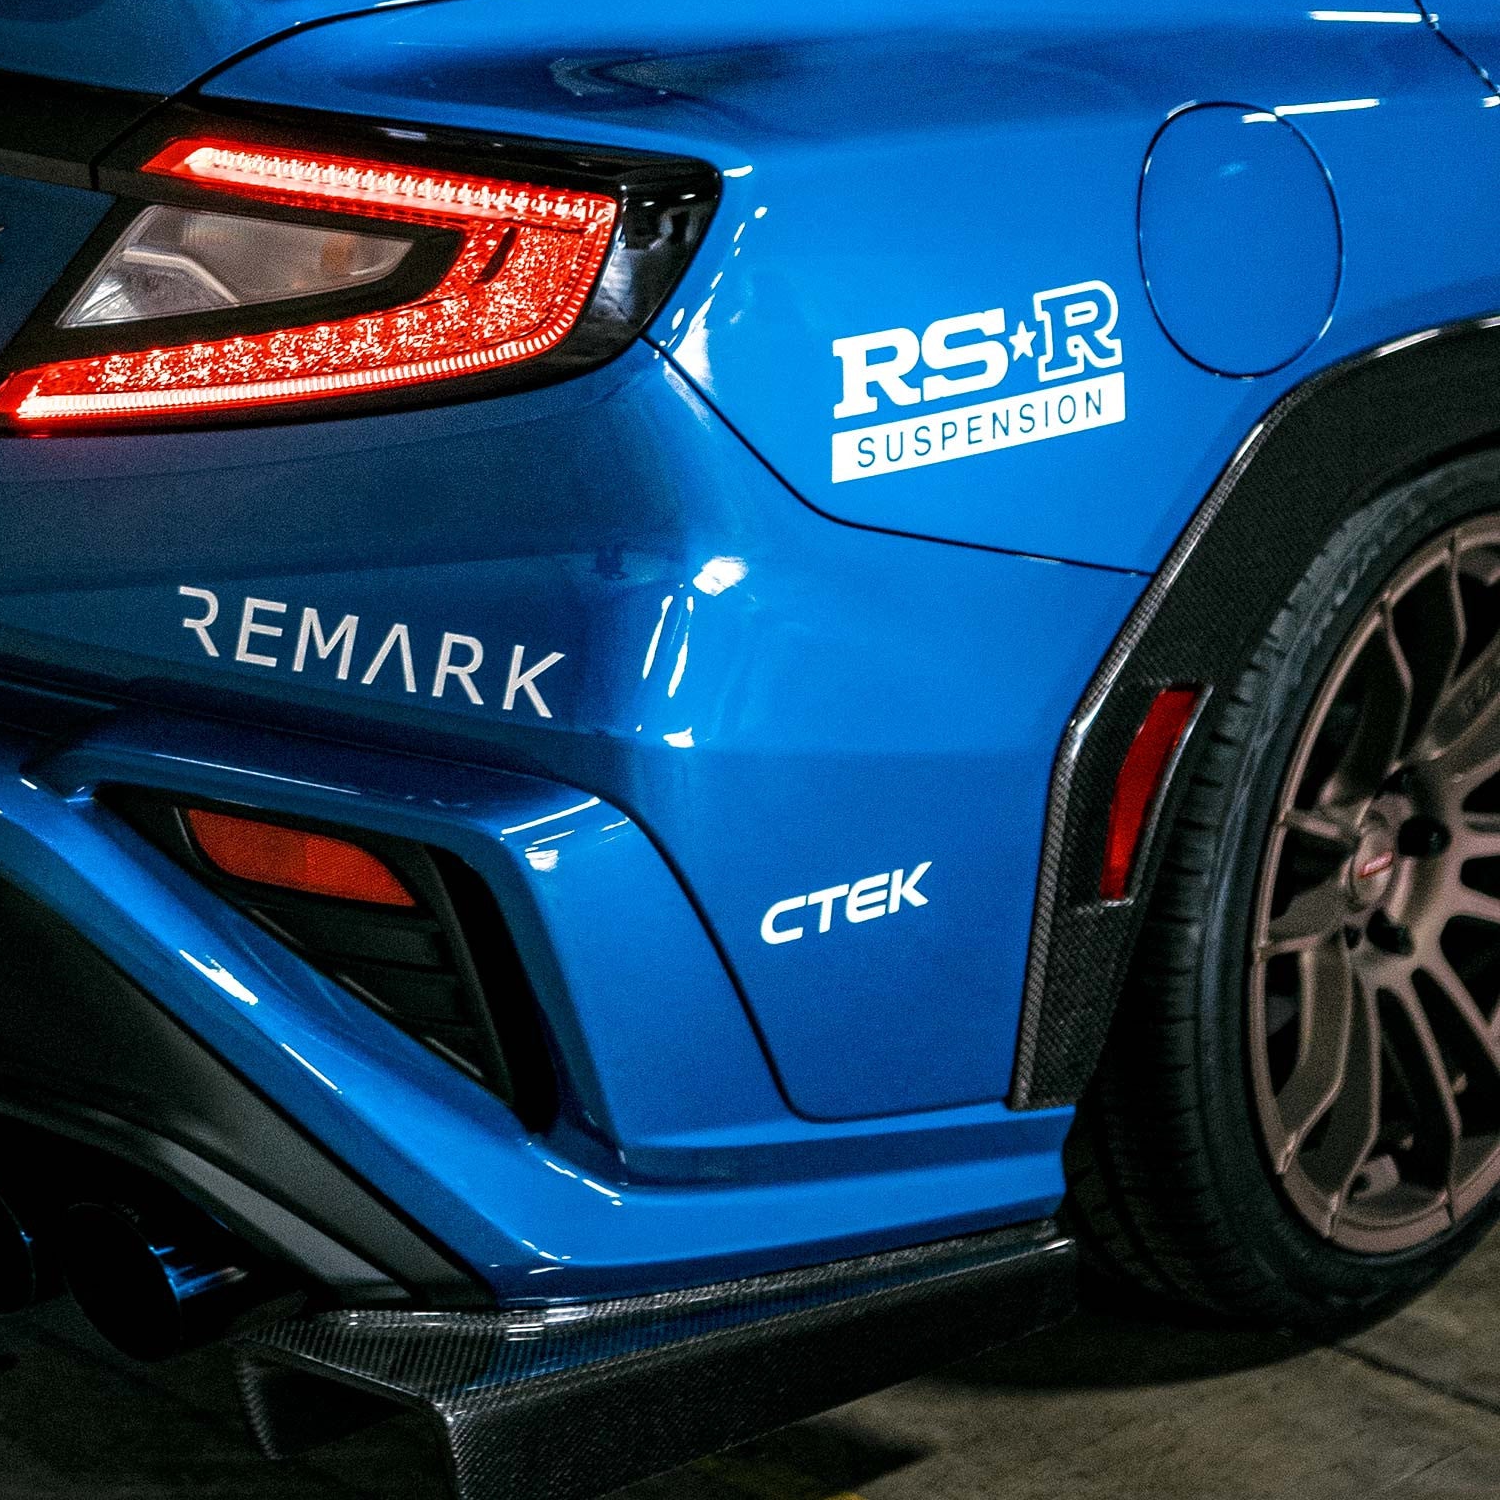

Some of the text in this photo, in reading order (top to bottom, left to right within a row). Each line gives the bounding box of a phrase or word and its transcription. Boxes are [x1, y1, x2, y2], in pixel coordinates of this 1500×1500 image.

[856, 387, 1103, 468] SUSPENSION
[178, 585, 566, 719] REMARK
[760, 861, 933, 945] CTEK
